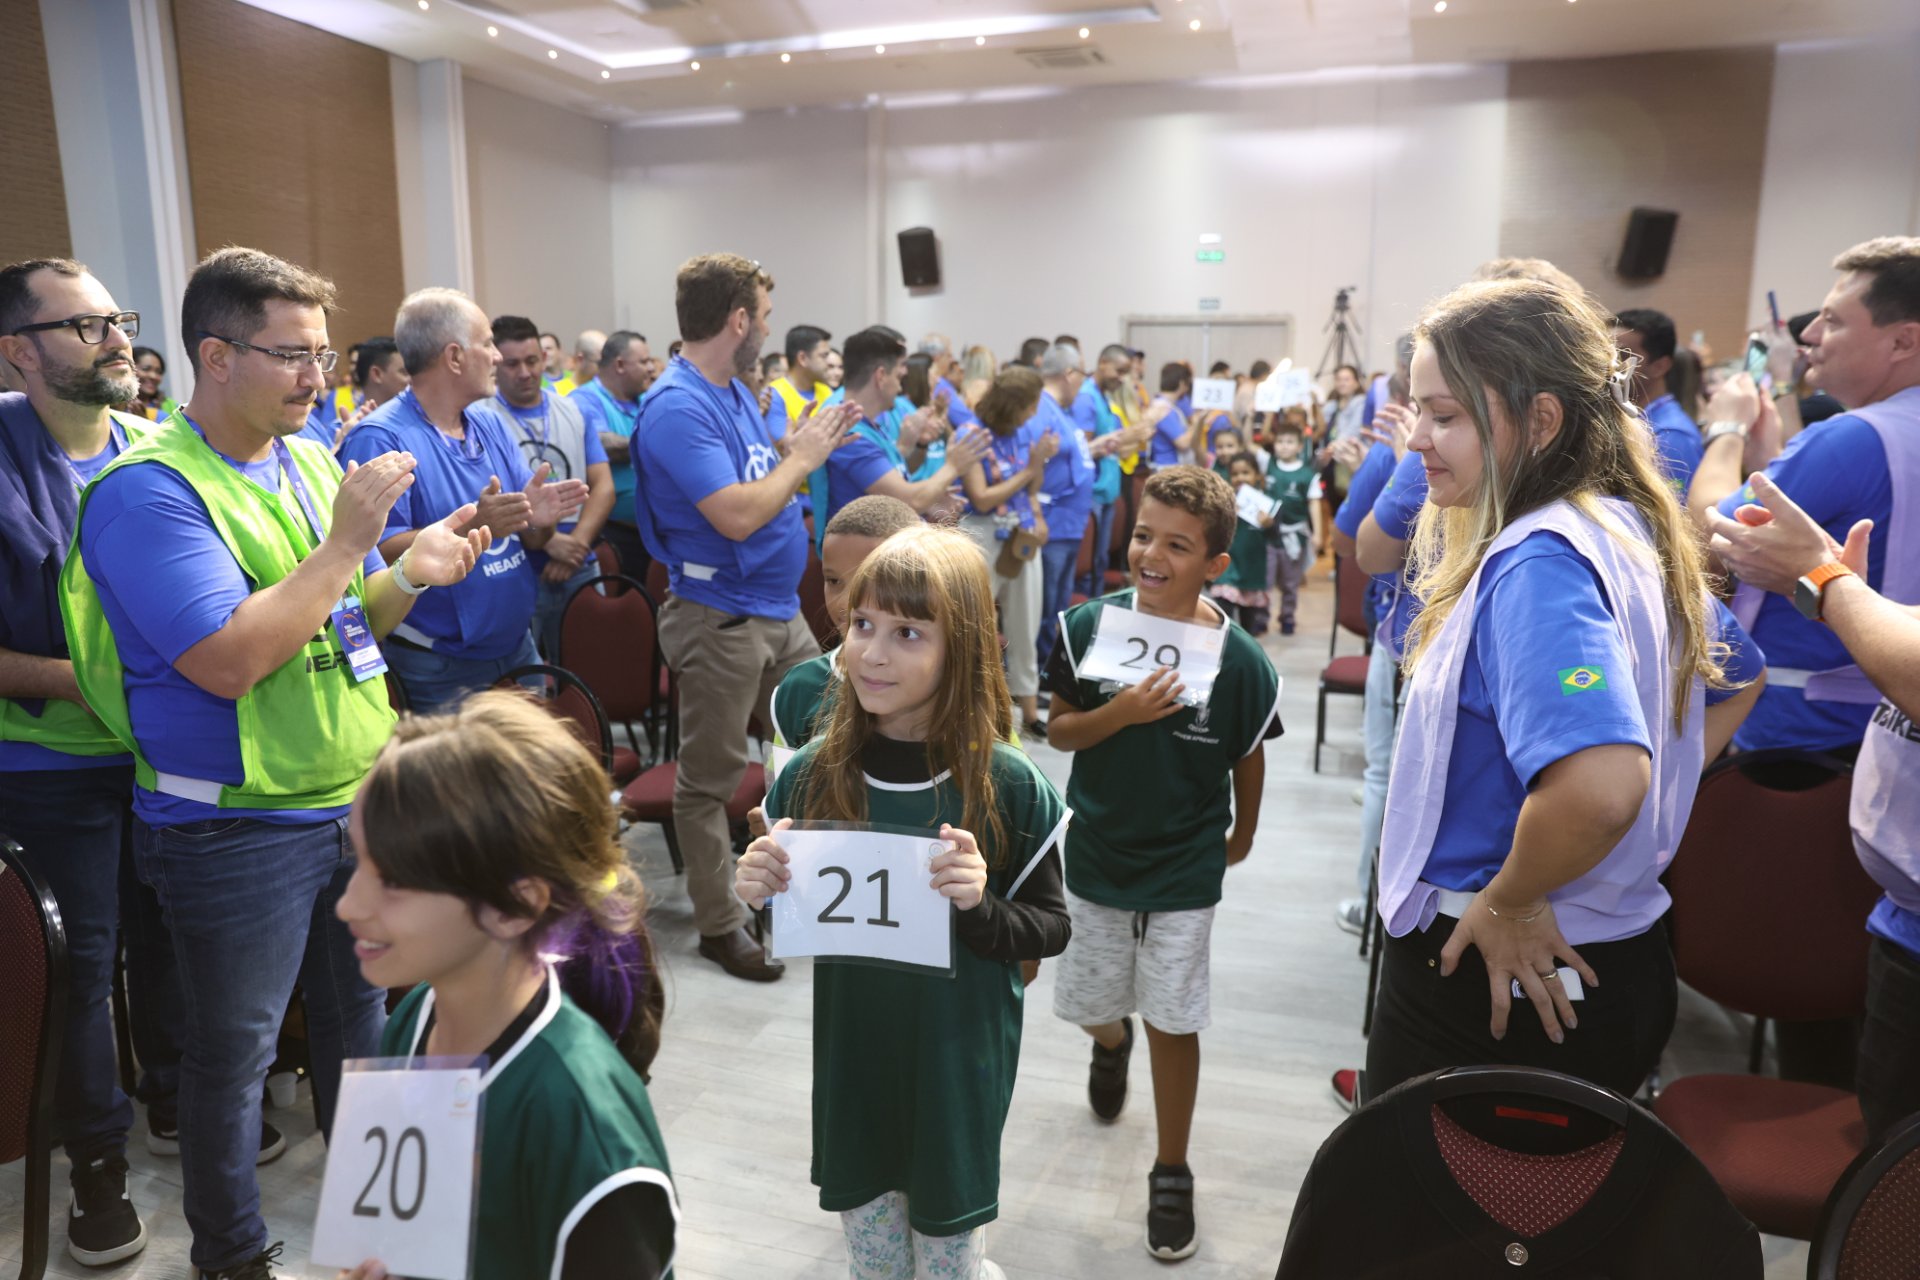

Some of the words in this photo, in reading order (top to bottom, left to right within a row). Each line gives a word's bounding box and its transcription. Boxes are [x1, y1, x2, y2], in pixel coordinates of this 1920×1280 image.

[1119, 637, 1181, 671] 29
[817, 866, 899, 928] 21
[352, 1126, 428, 1222] 20
